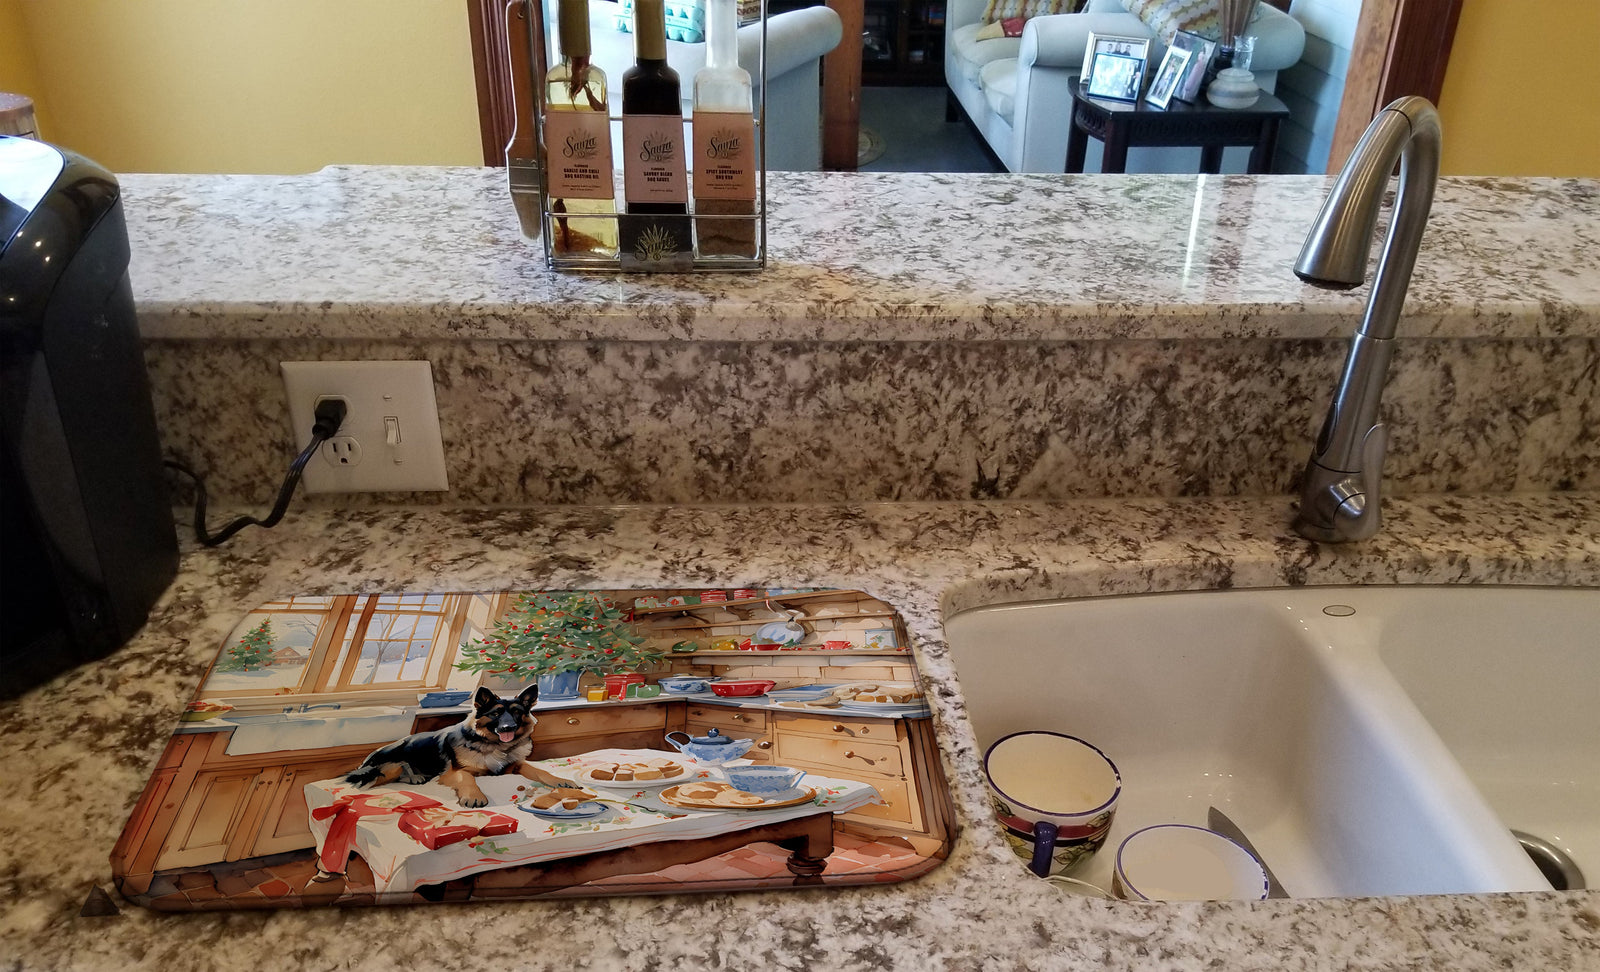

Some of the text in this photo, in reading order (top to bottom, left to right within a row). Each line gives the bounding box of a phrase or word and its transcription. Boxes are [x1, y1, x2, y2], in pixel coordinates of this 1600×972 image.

[562, 136, 597, 158] Sauza
[640, 140, 673, 161] Sauza
[706, 136, 740, 158] Sauza
